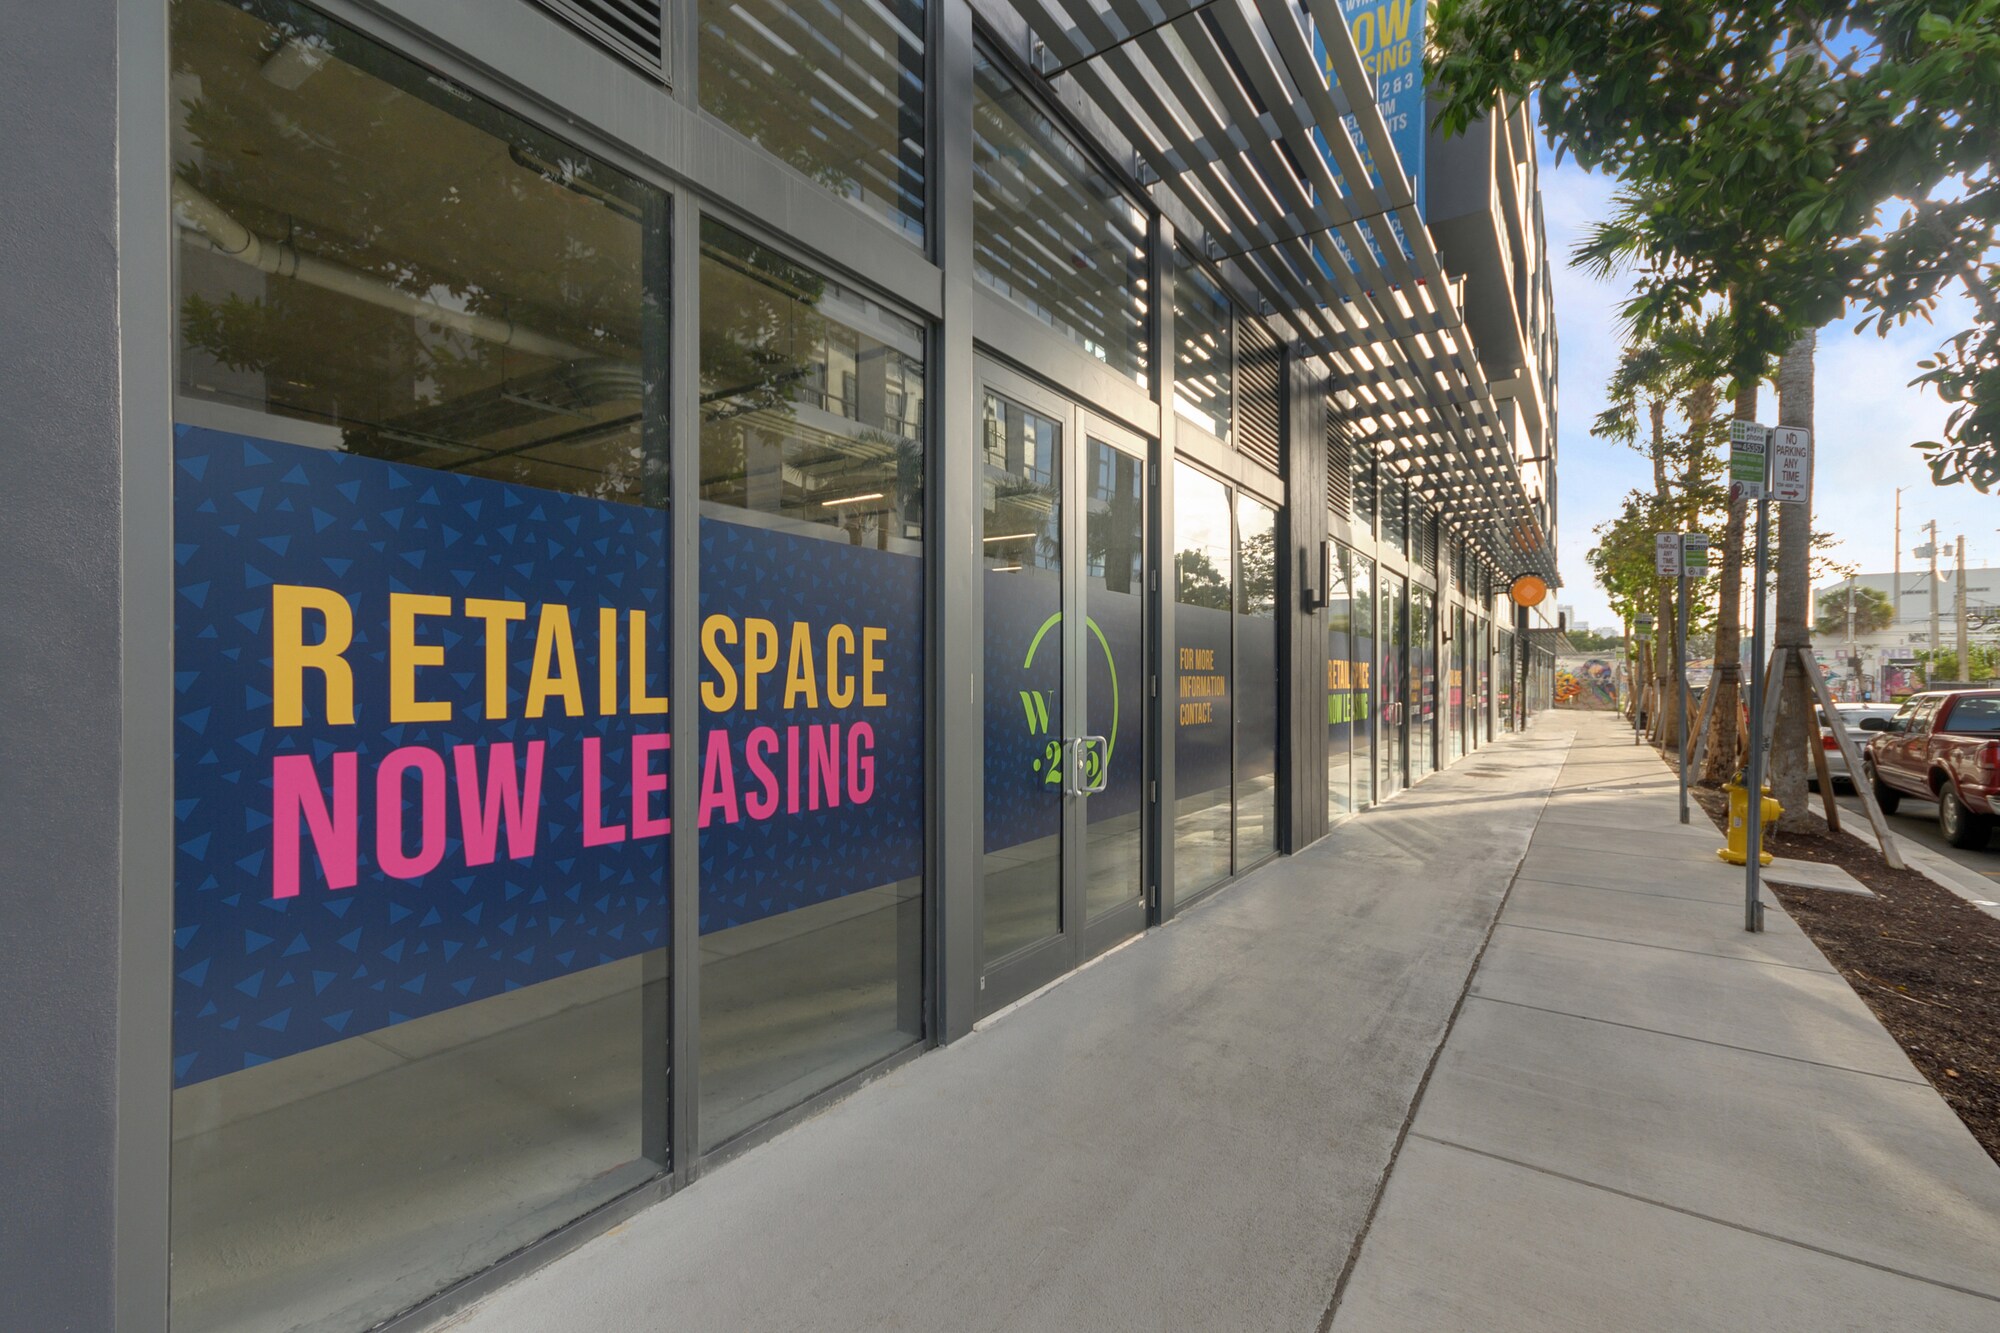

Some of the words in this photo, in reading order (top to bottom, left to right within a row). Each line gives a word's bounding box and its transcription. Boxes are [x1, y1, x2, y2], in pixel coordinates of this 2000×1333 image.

[1382, 82, 1390, 98] 2
[1405, 72, 1413, 89] 3
[1786, 433, 1797, 445] NO
[1776, 445, 1806, 458] PARKING
[1783, 458, 1799, 469] ANY
[1781, 470, 1800, 482] TIME
[273, 584, 669, 728] RETAIL
[700, 614, 888, 713] SPACE
[1180, 648, 1194, 670] FOR
[1195, 648, 1214, 671] MORE
[1180, 675, 1225, 698] INFORMATION
[1180, 702, 1213, 726] CONTACT:
[272, 741, 546, 900] NOW
[583, 721, 876, 848] LEASING
